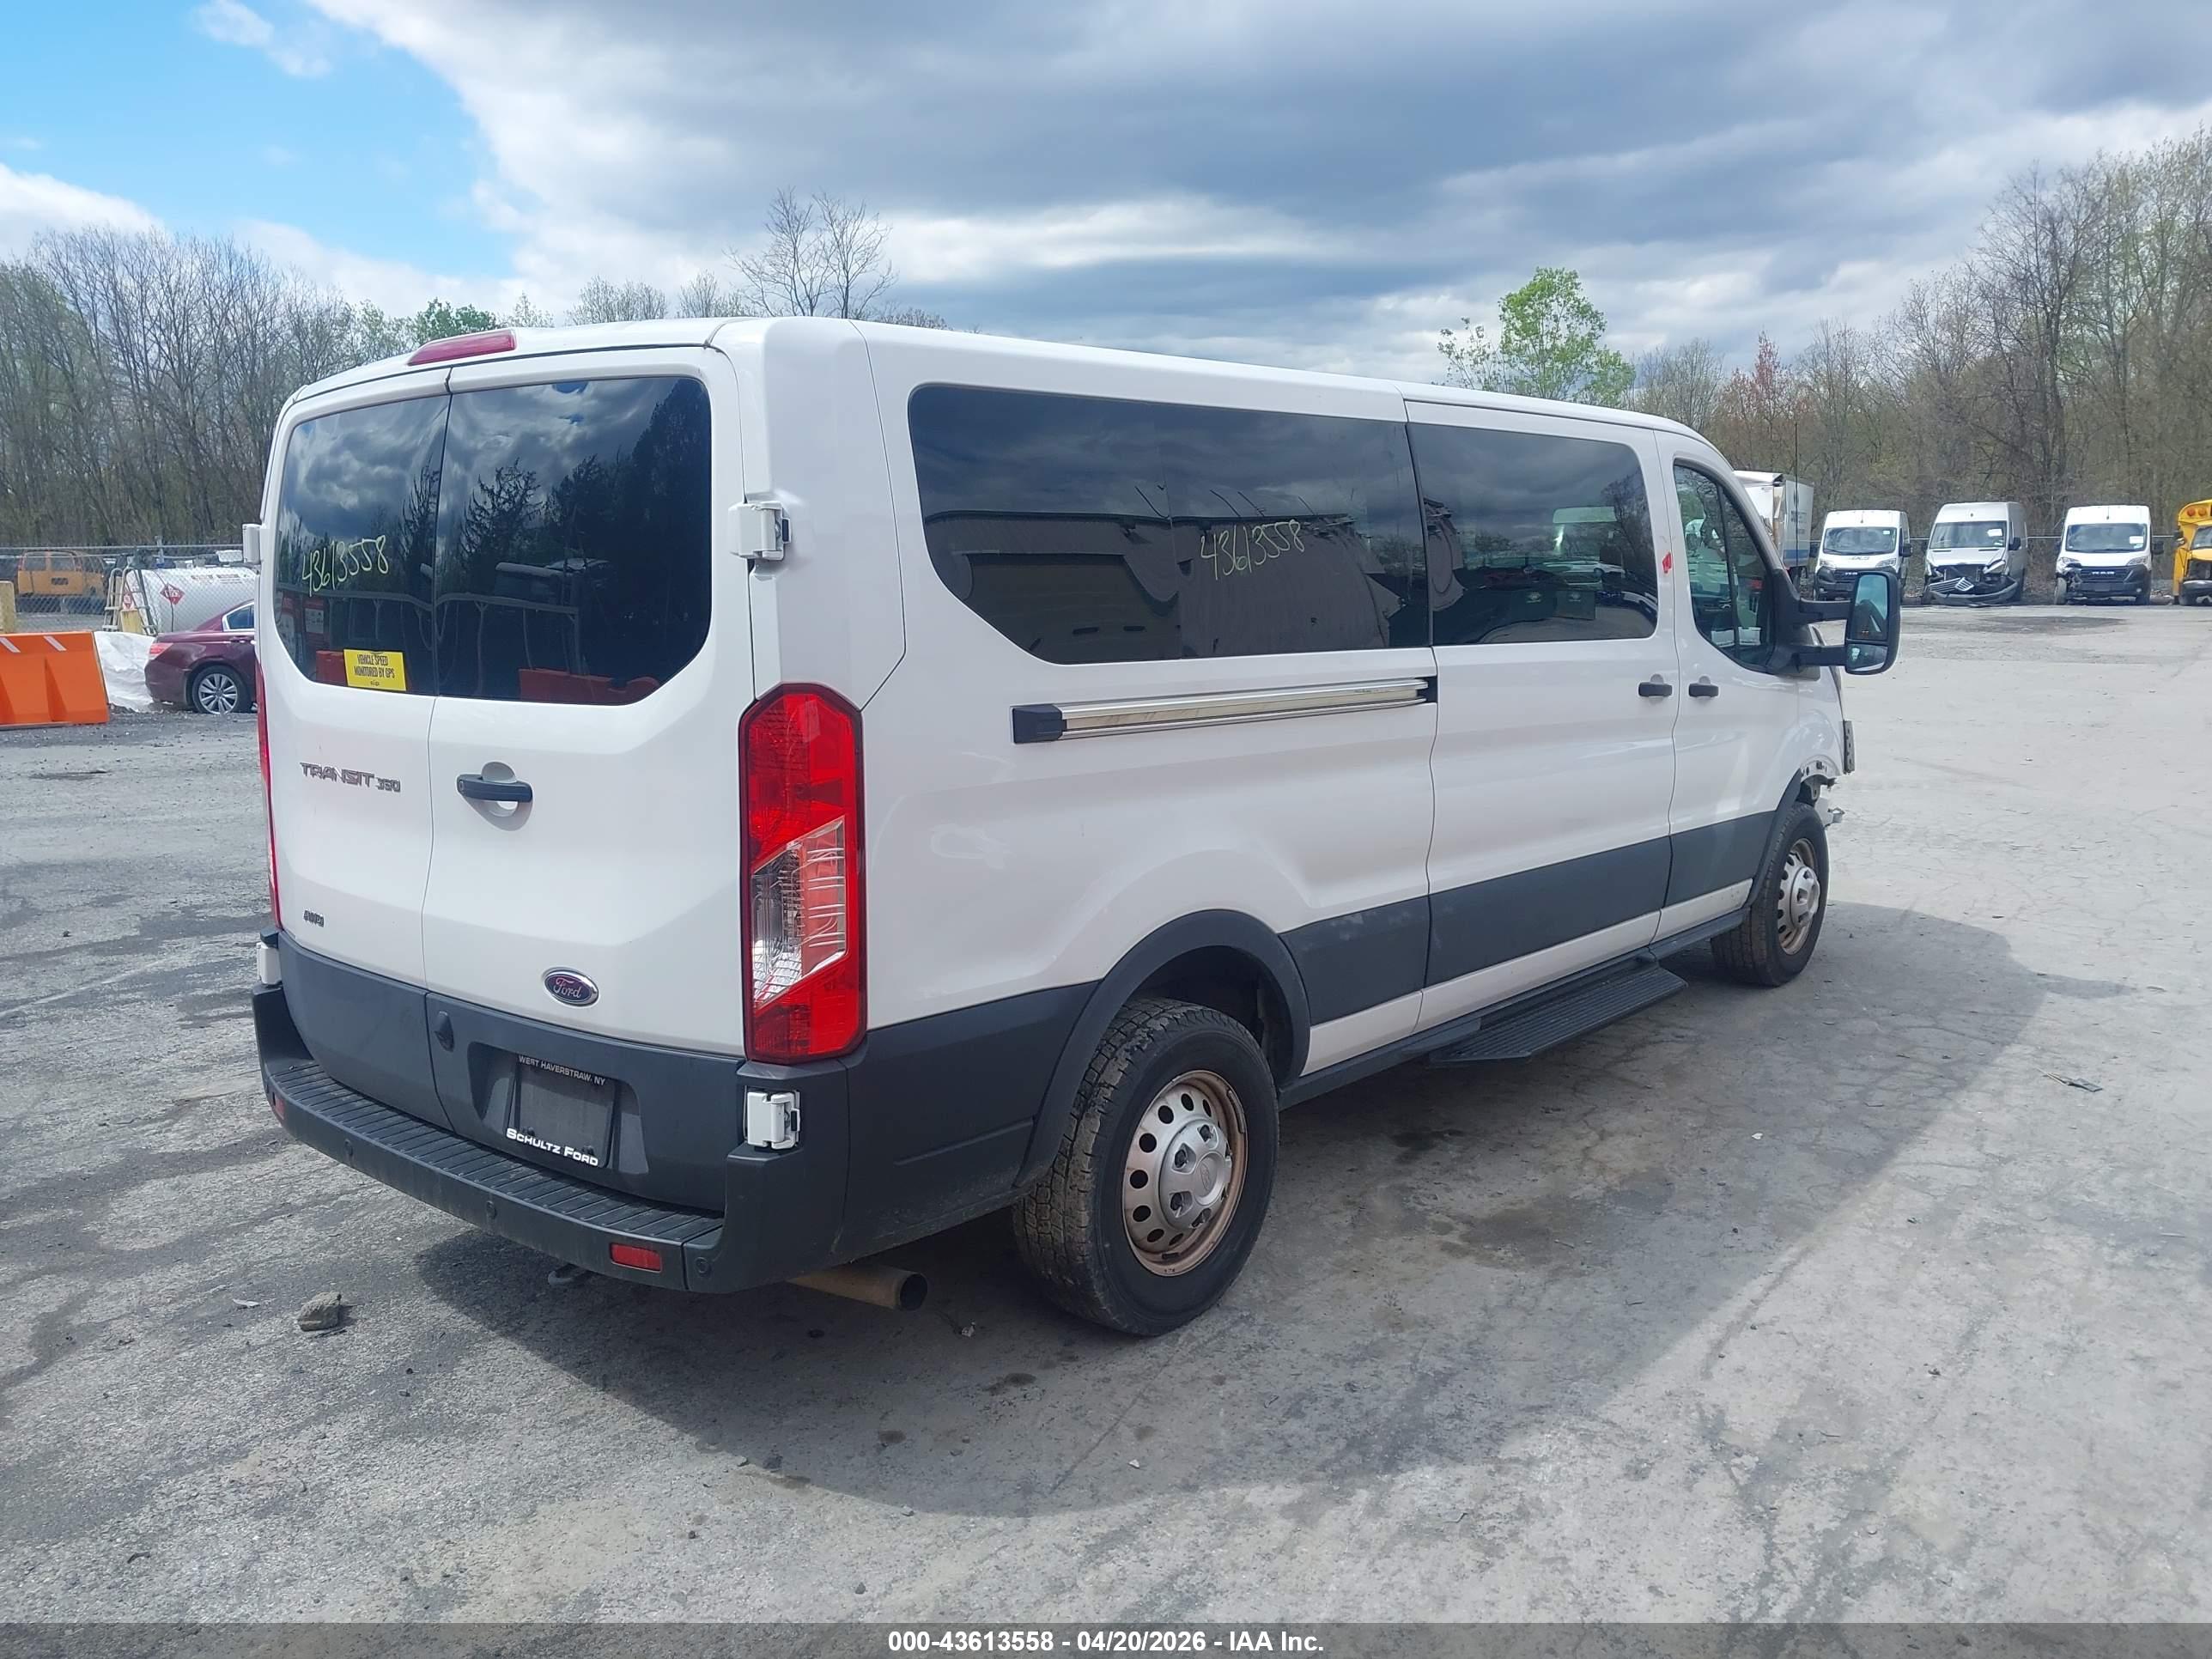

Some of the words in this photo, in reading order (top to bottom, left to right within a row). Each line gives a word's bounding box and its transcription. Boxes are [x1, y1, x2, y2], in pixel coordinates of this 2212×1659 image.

[1200, 519, 1304, 580] 43613558
[301, 534, 389, 598] 43613558
[356, 653, 374, 665] VEHICLE
[375, 654, 389, 666] SPEED
[353, 665, 378, 678] MONITORED
[379, 666, 385, 678] BY
[386, 667, 395, 679] GPS
[299, 762, 375, 787] TRANSIT
[553, 977, 582, 999] Ford
[593, 1076, 606, 1086] NY
